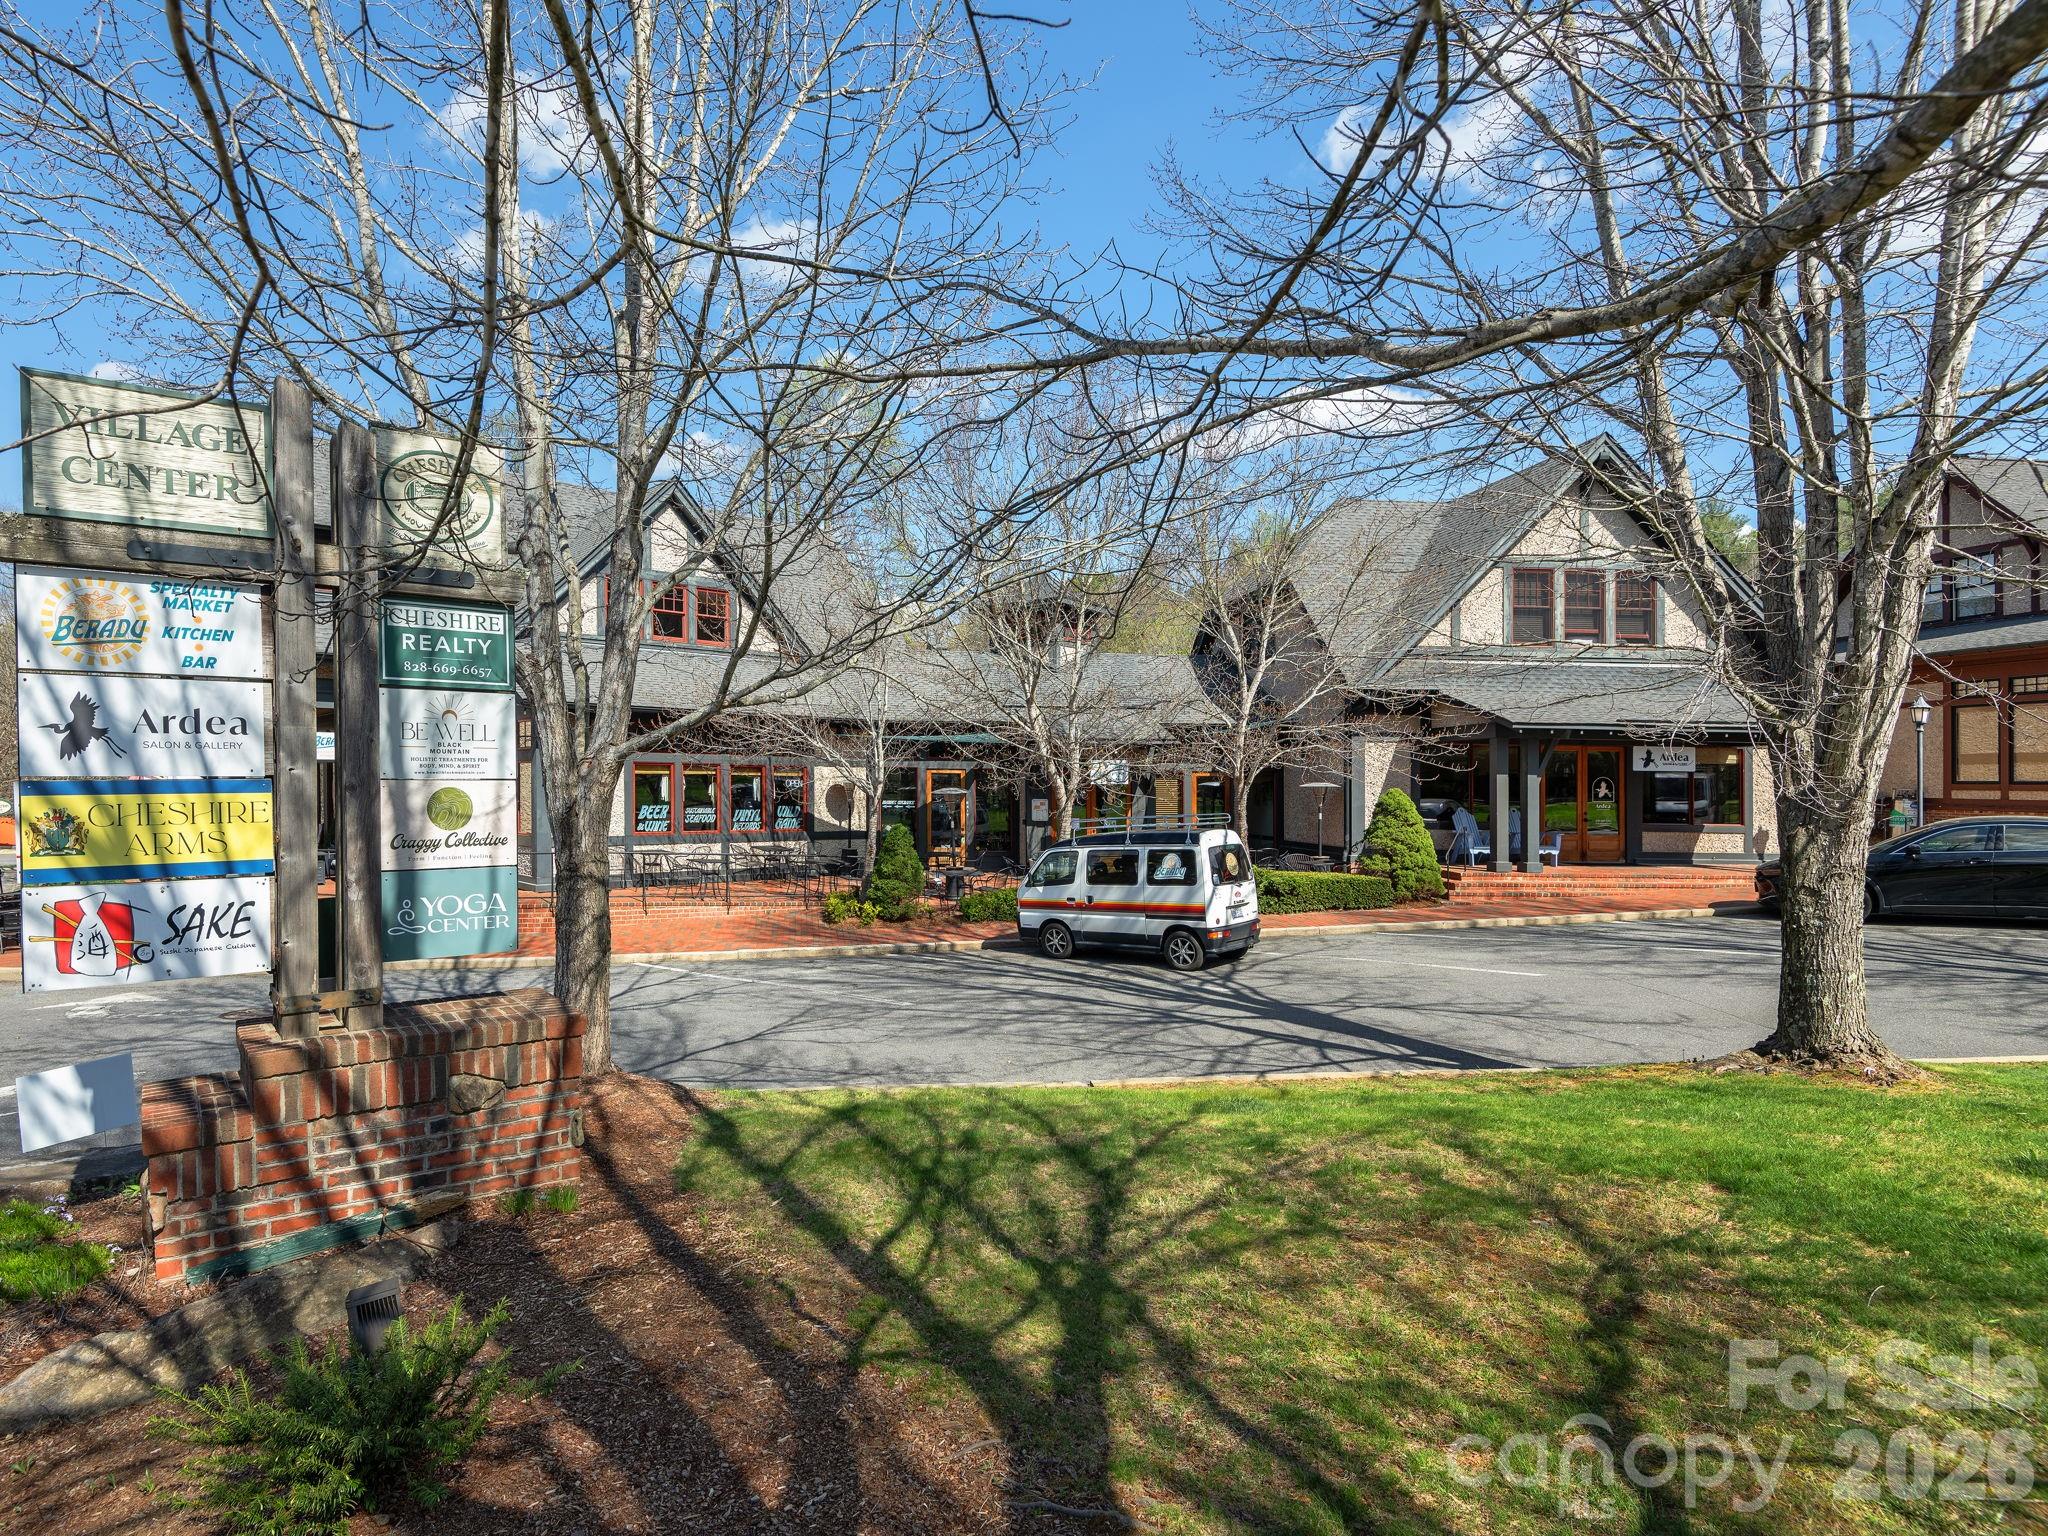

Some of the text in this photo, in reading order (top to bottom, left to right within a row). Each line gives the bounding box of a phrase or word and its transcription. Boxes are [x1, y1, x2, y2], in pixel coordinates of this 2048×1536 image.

[50, 400, 249, 456] VILLAGE
[60, 455, 242, 501] CENTER
[149, 581, 241, 599] SPECIALTY
[161, 597, 234, 613] MARKET
[51, 615, 148, 643] BERADU
[388, 607, 501, 632] CHESHIRE
[161, 626, 235, 642] KITCHEN
[402, 633, 492, 655] REALTY
[181, 655, 217, 669] BAR
[403, 660, 492, 678] 828-669-6657
[132, 708, 249, 736] Ardea
[401, 721, 496, 742] BE WELL
[142, 740, 243, 750] SALON & GALLERY
[87, 801, 269, 828] CHESHIRE
[637, 804, 670, 820] BEER
[684, 814, 717, 823] SEAFOOD
[732, 821, 762, 831] RECORDS
[125, 831, 228, 857] ARMS
[389, 831, 509, 854] Craggy Collective
[420, 892, 507, 917] YOGA
[161, 900, 256, 946] SAKE
[427, 914, 510, 933] CENTER
[159, 942, 257, 956] Sushi Japanese Cuisine
